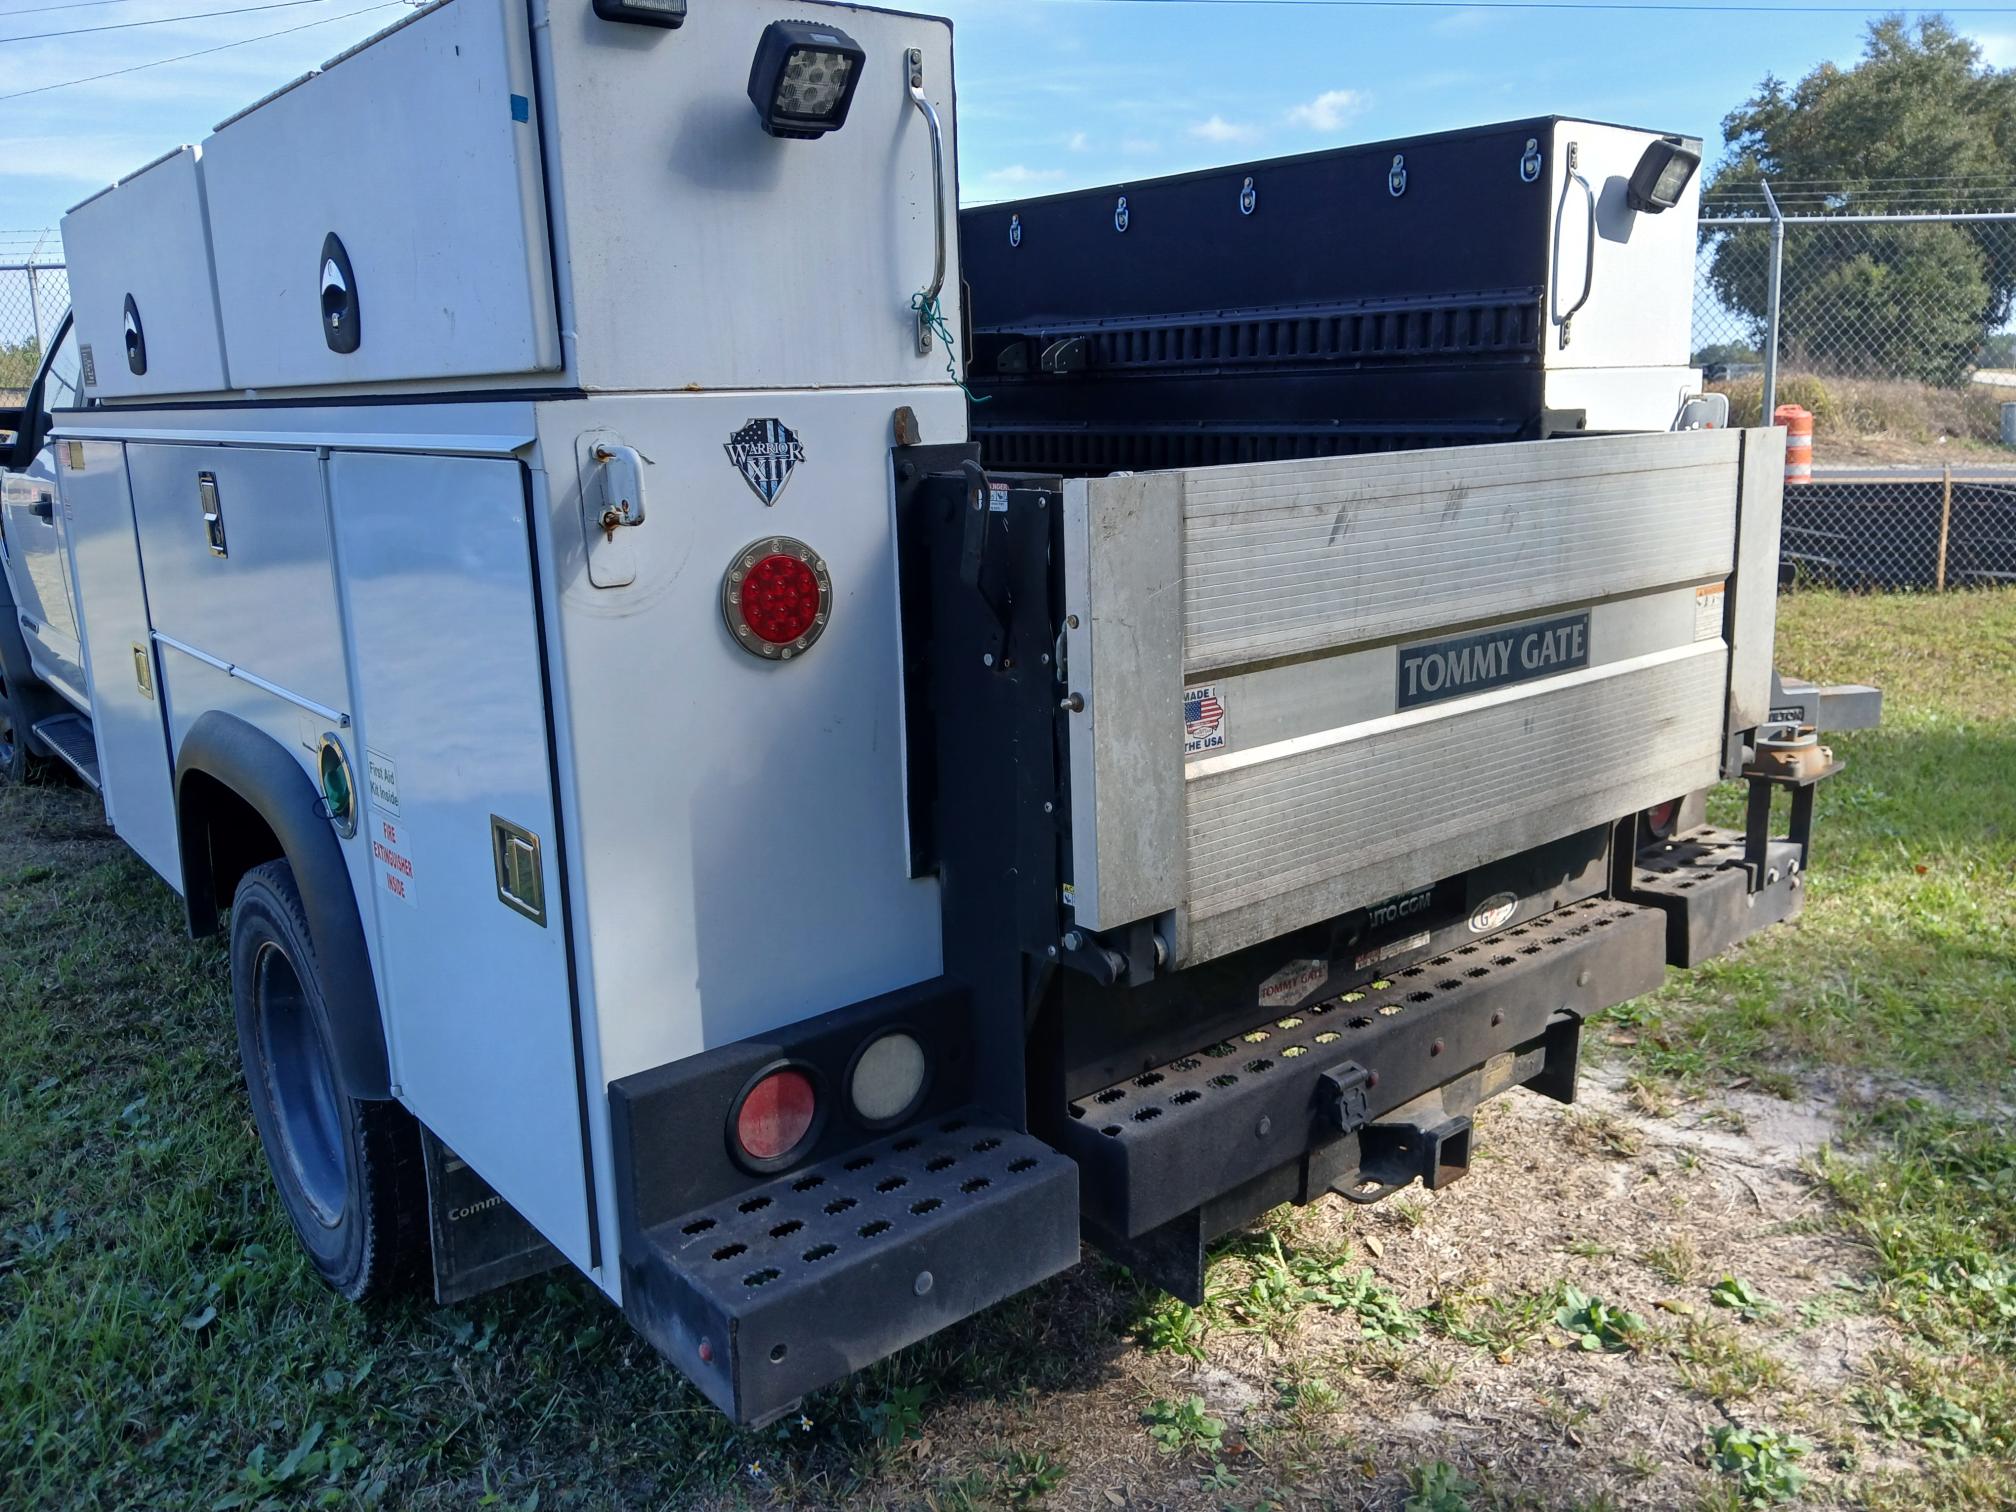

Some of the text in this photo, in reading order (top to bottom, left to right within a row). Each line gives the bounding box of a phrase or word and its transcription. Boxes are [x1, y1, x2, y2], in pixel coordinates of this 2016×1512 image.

[725, 441, 805, 464] WARRIOR
[1405, 624, 1585, 696] TOMMY GATE
[1184, 689, 1210, 701] MADE
[1184, 736, 1223, 752] THE USA
[368, 761, 395, 785] First Aid
[370, 780, 399, 807] Kit Inside
[383, 821, 396, 844] FIRE
[373, 841, 414, 880] EXTINGUISHER
[386, 872, 406, 899] INSIDE
[1369, 892, 1431, 928] UTO.COM
[1262, 977, 1298, 998] TOMMY
[447, 1195, 505, 1221] Comm
